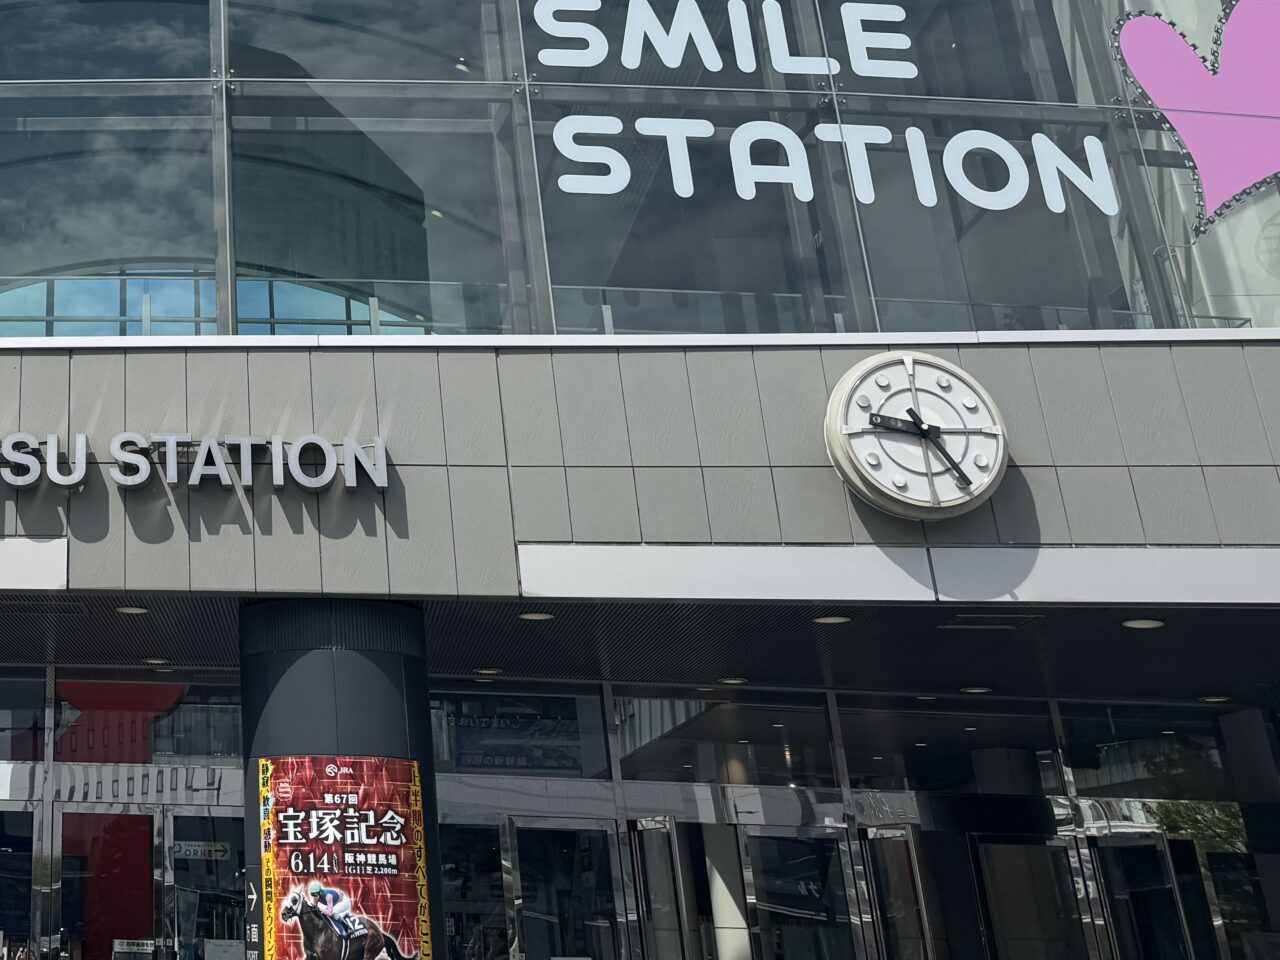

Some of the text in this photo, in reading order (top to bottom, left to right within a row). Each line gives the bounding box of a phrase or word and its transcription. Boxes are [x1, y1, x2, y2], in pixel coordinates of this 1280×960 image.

[552, 114, 1119, 216] STATION
[109, 432, 388, 491] STATION
[324, 793, 358, 805] 第67回
[277, 808, 407, 845] 宝塚記念
[184, 849, 214, 857] ORNE
[290, 851, 331, 874] 6.14
[344, 852, 398, 866] 阪神競馬場
[410, 770, 431, 957] 上半期のすべてがここ
